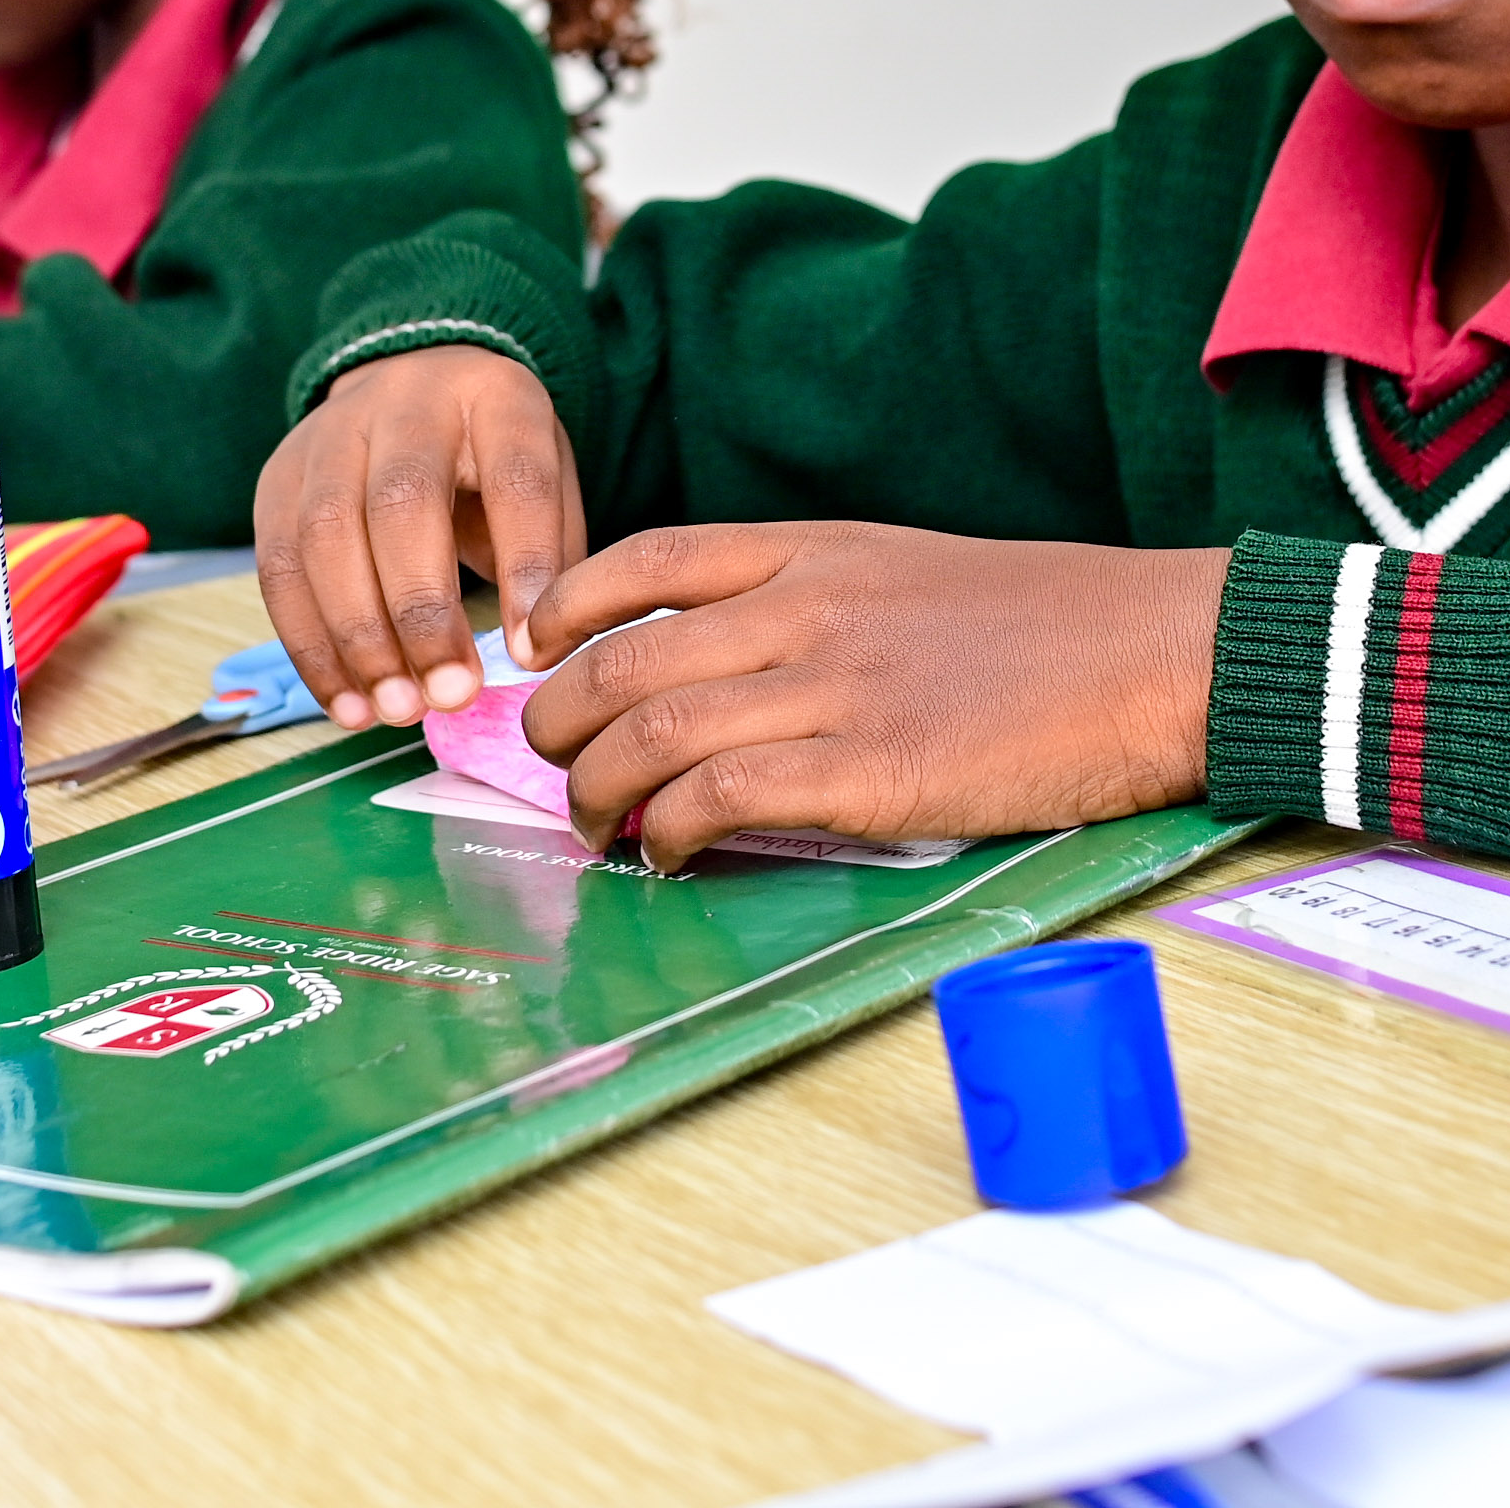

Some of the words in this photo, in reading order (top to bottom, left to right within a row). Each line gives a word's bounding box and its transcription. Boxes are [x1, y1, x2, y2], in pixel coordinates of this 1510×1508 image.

[735, 832, 845, 858] Nathan
[451, 842, 542, 862] BOOK
[542, 854, 697, 882] EERCISE
[1268, 886, 1308, 899] 20
[1301, 896, 1338, 908] 19
[1330, 906, 1367, 919] 18
[1361, 917, 1398, 928] 17
[1392, 925, 1430, 937] 16
[172, 924, 308, 955] SCHOOL
[1423, 934, 1461, 947] 15
[1455, 945, 1493, 958] 14
[304, 946, 419, 974] RIDGE
[414, 962, 511, 986] SAGE
